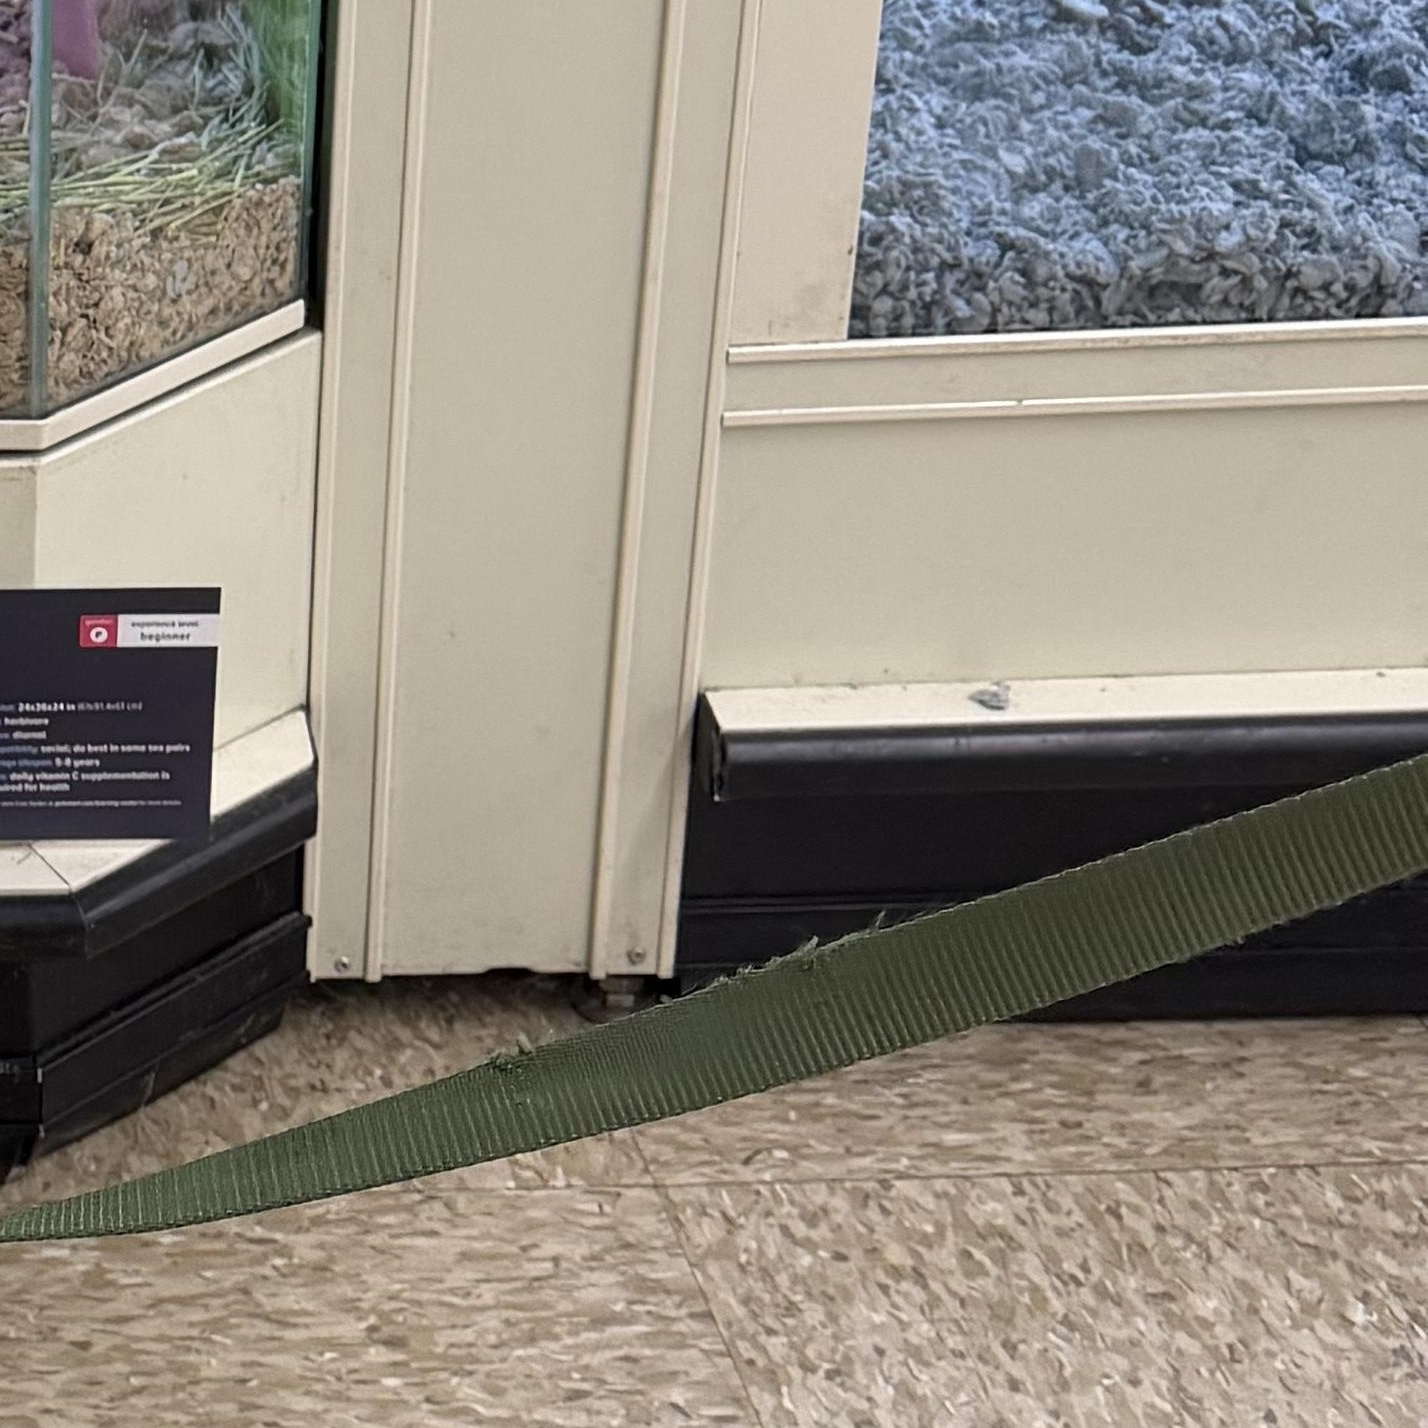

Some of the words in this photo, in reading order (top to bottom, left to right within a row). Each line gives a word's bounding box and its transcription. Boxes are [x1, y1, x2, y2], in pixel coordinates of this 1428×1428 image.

[140, 632, 190, 642] beginner
[73, 744, 85, 753] do
[88, 744, 108, 753] best
[110, 744, 119, 753] in
[166, 744, 190, 753] pairs
[73, 758, 100, 768] years
[9, 772, 34, 783] daily
[36, 772, 70, 780] vitamin
[72, 772, 79, 780] C
[81, 771, 159, 782] supplementation
[161, 771, 170, 780] is
[24, 783, 37, 792] for
[39, 783, 70, 792] health
